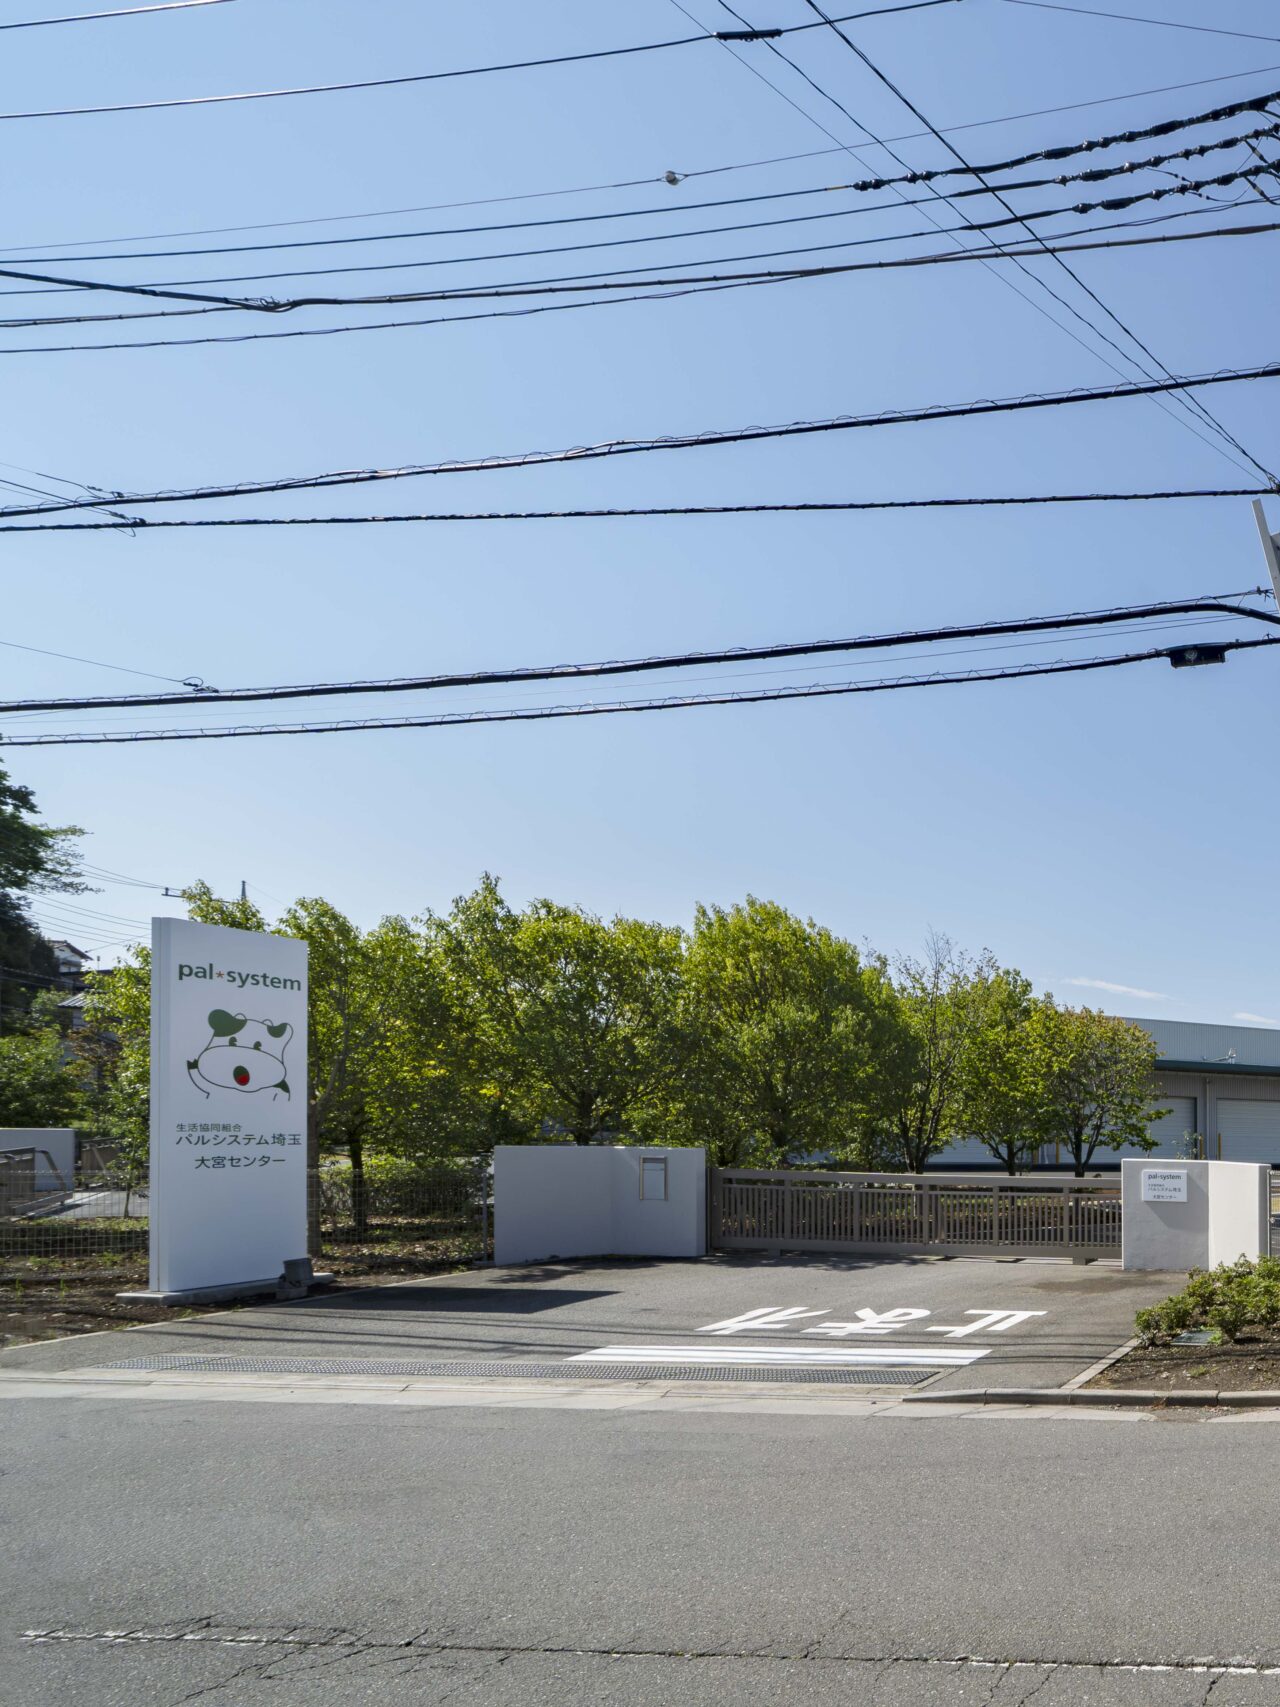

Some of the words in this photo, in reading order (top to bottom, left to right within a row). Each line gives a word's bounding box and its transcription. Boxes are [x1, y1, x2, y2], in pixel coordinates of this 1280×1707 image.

[176, 1123, 242, 1133] 生活協同組合
[175, 1133, 302, 1146] パルシステム埼玉
[194, 1155, 286, 1169] 大宮センター
[693, 1306, 1048, 1338] 止まれ
